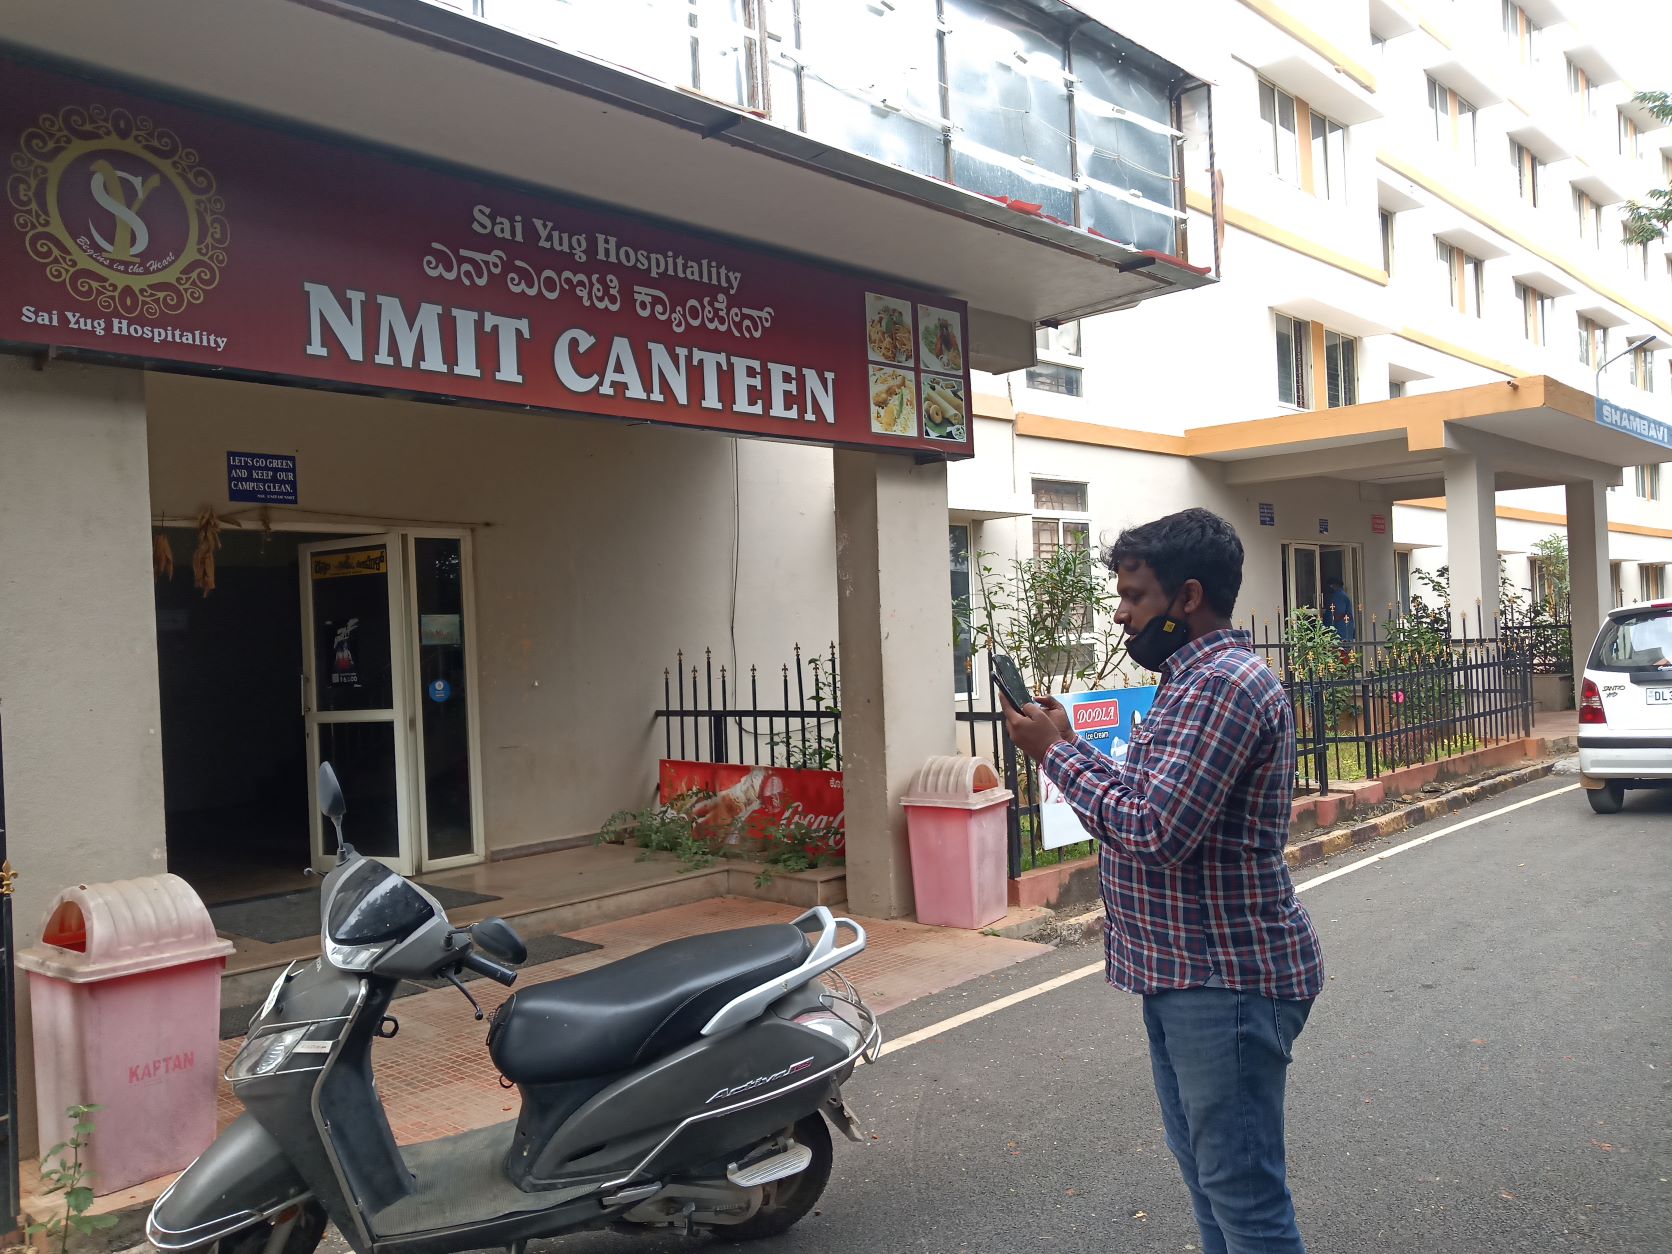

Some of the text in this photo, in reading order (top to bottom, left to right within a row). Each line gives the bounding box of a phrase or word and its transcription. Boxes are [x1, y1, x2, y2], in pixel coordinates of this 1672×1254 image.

[77, 236, 175, 272] Begins in the Heart
[472, 204, 741, 294] Sai Yug Hospitality
[21, 306, 227, 351] Sai Yug Hospitality
[304, 282, 835, 423] NMIT CANTEEN
[1603, 405, 1667, 443] SHAMBAVI
[230, 457, 293, 468] LET'S GO GREEN
[231, 469, 294, 480] AND KEEP OUR
[231, 481, 293, 493] CAMPUS CLEAN.
[1077, 706, 1115, 723] DODLA
[1094, 731, 1109, 739] Cream
[128, 1051, 194, 1083] KAPTAN
